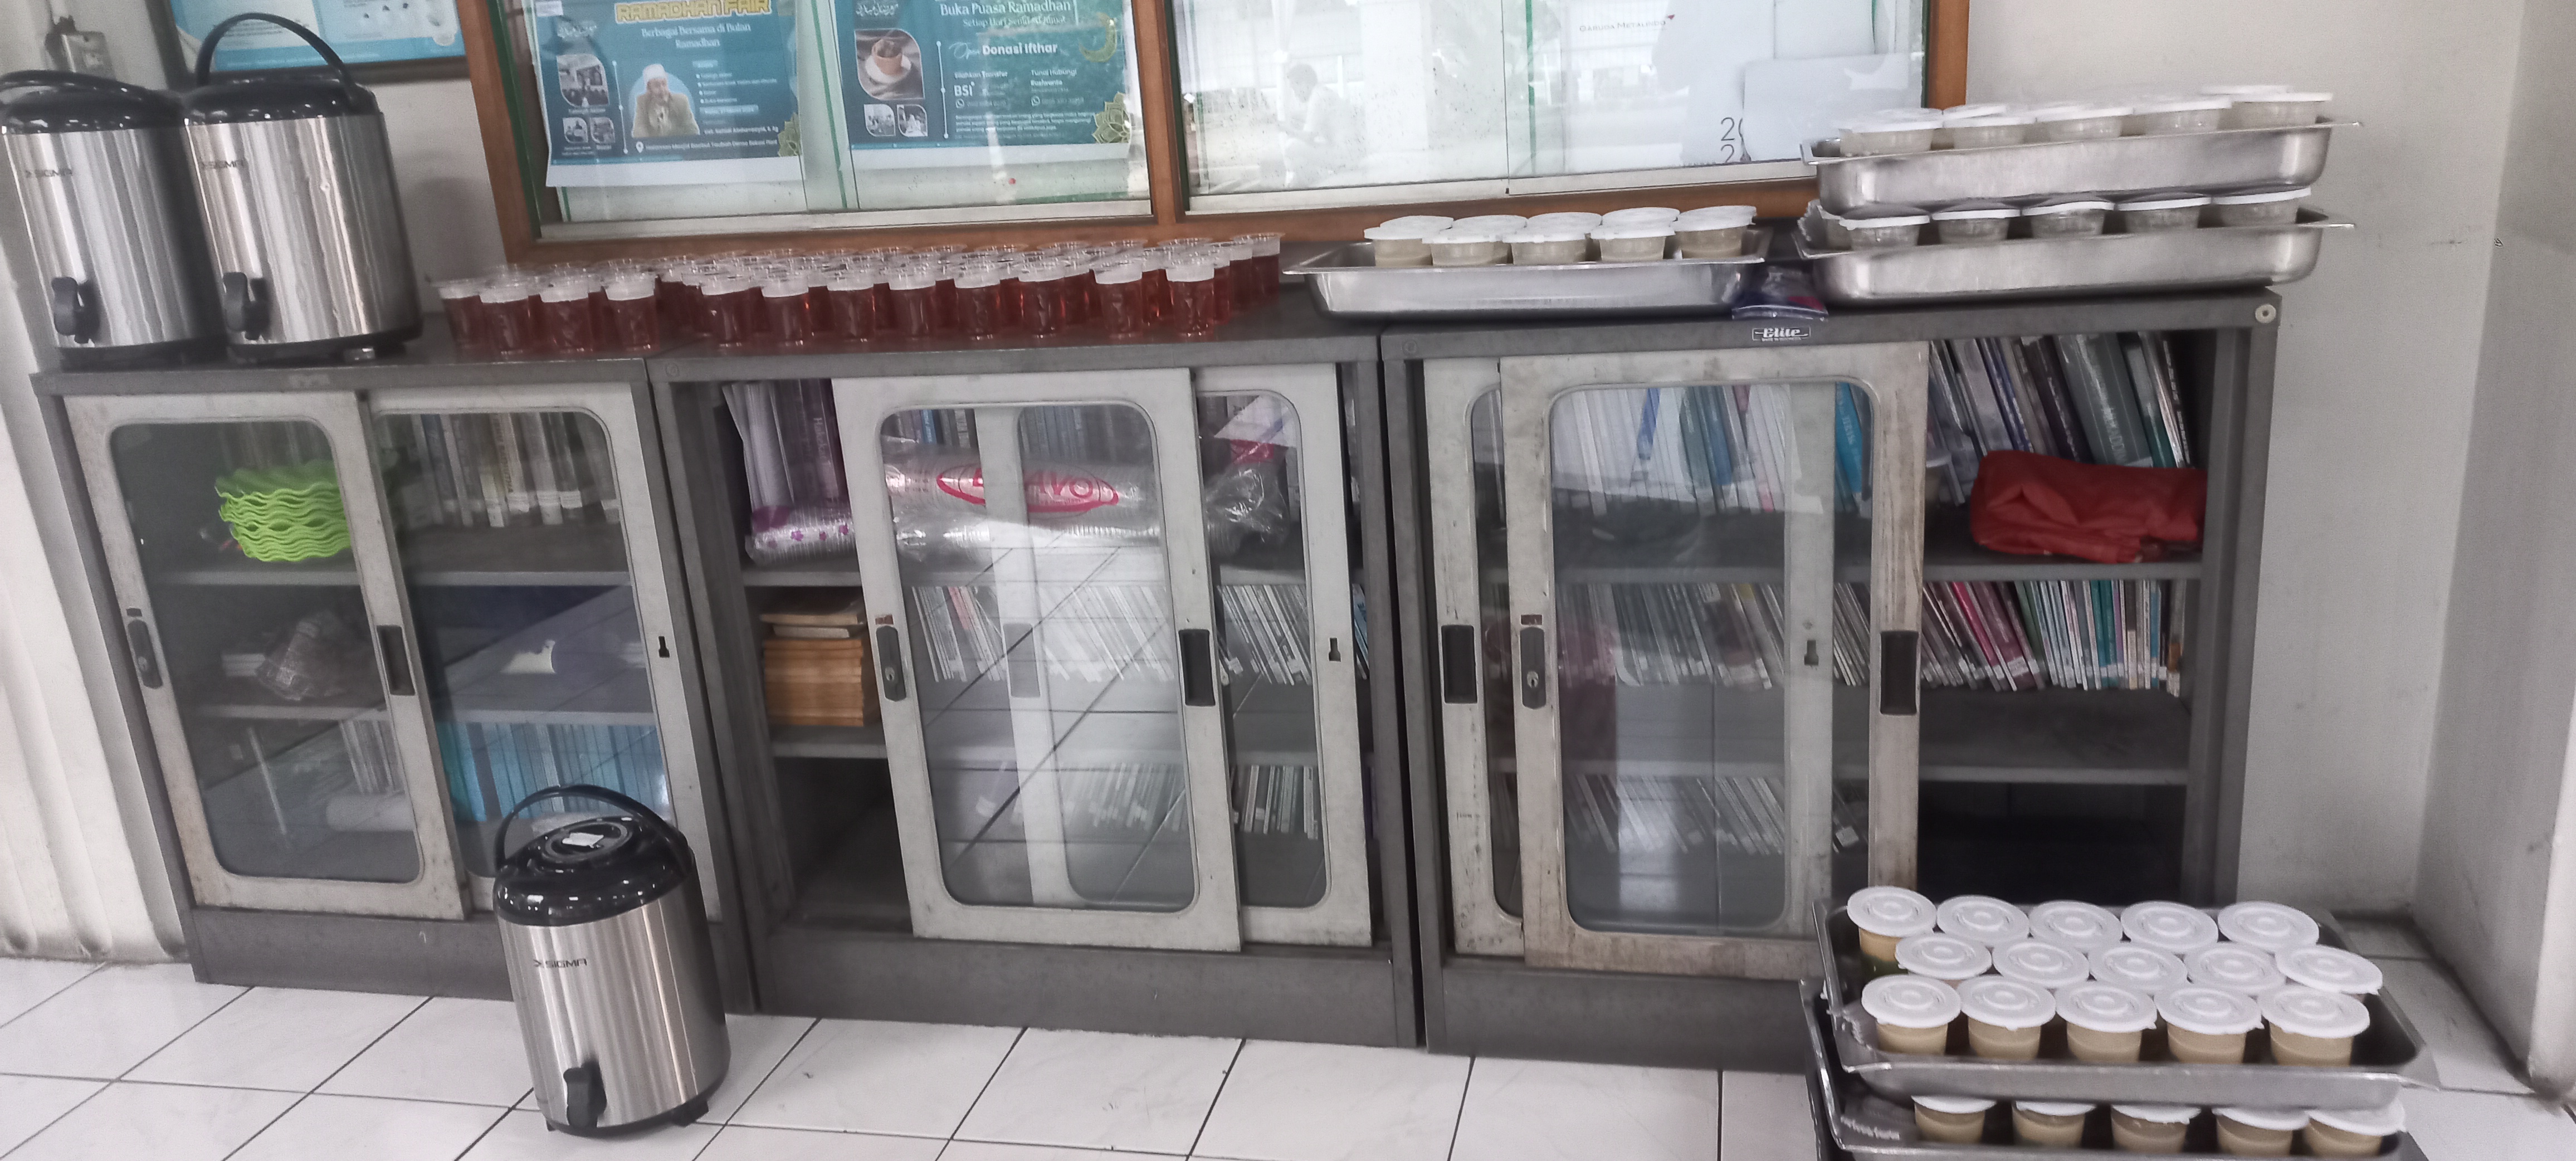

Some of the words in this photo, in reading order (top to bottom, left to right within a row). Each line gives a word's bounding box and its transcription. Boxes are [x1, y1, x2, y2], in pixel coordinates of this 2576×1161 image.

[615, 0, 723, 23] RAMADHAN
[940, 3, 970, 16] Buka
[972, 2, 1006, 14] Puasa
[1008, 0, 1071, 13] Ramadhan
[641, 27, 679, 38] Berbagai
[679, 25, 716, 35] Bersama
[726, 22, 751, 32] Bulan
[675, 37, 720, 48] Ramadhan
[982, 42, 1023, 55] Donasi
[1024, 42, 1058, 54] Ifthar
[954, 85, 973, 96] BSI
[1760, 327, 1802, 338] Elite
[545, 958, 588, 968] SIGMA
